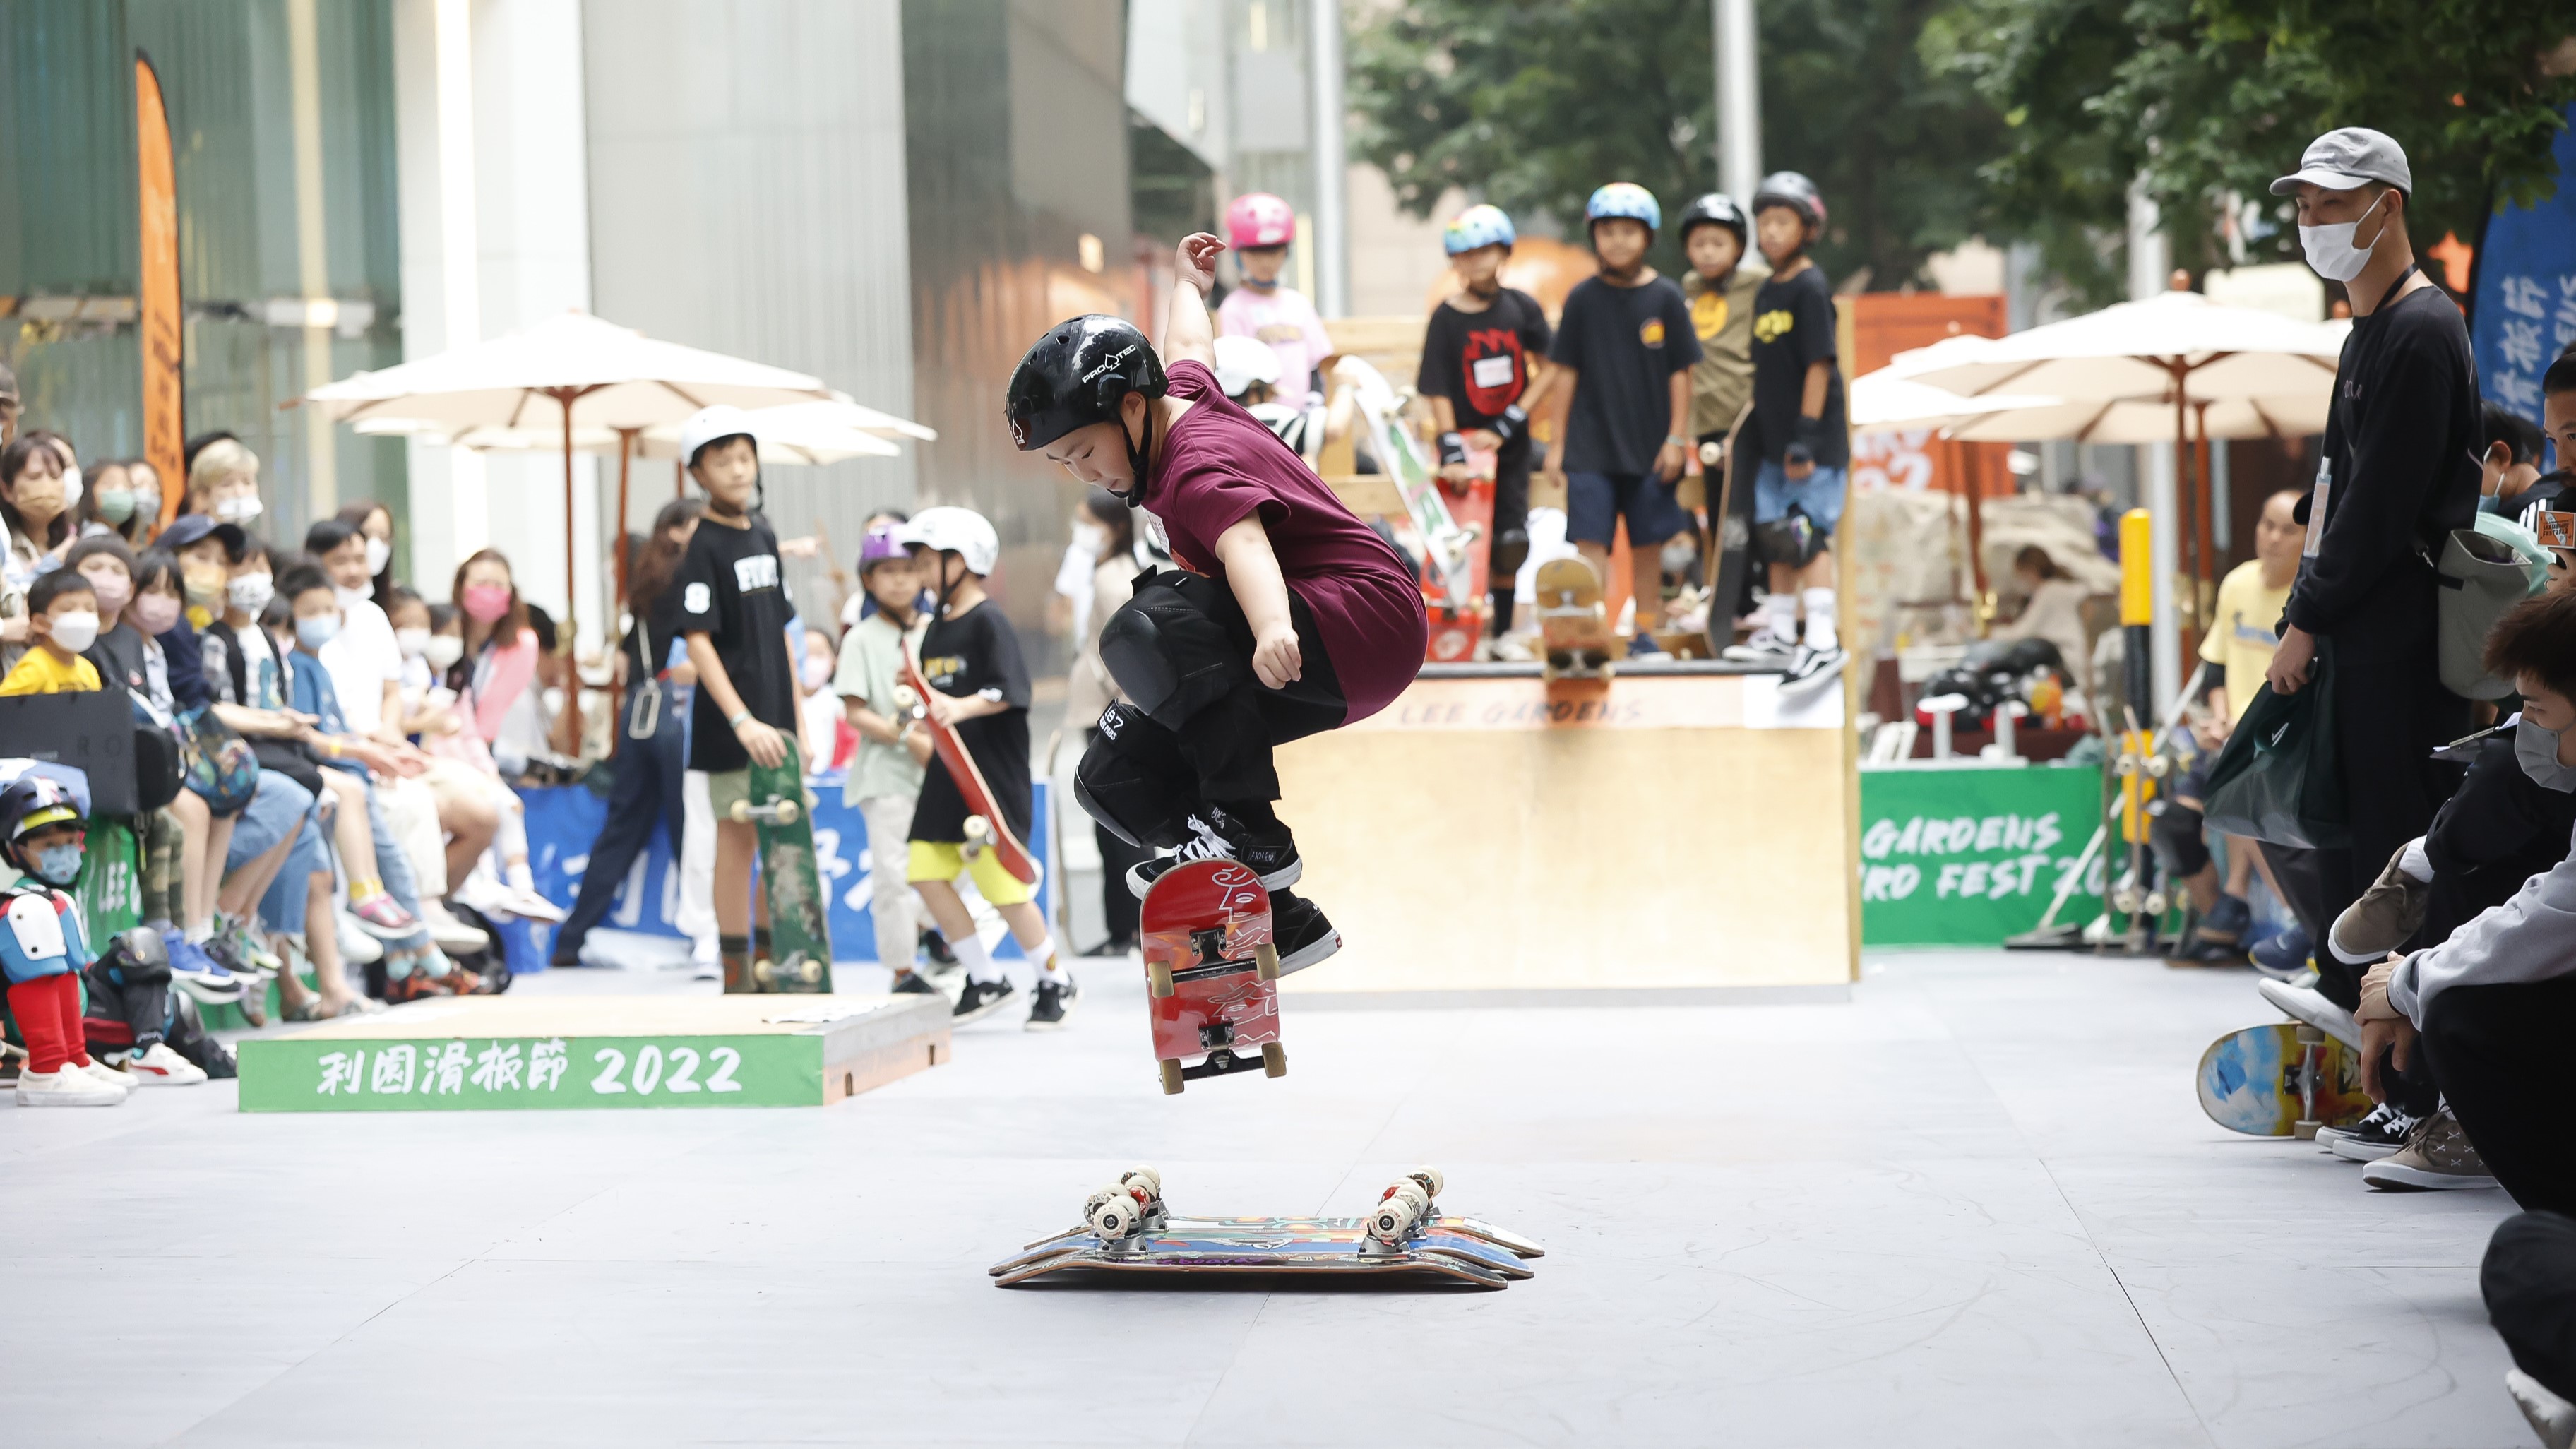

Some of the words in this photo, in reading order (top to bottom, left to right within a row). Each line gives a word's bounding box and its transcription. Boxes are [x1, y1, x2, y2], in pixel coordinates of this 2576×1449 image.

[1400, 703, 1465, 724] LEE
[1482, 700, 1642, 724] GARDENS
[1862, 812, 2062, 859] GARDENS
[1860, 862, 1922, 902] RD
[1936, 854, 2051, 900] FEST
[590, 1044, 742, 1095] 2022
